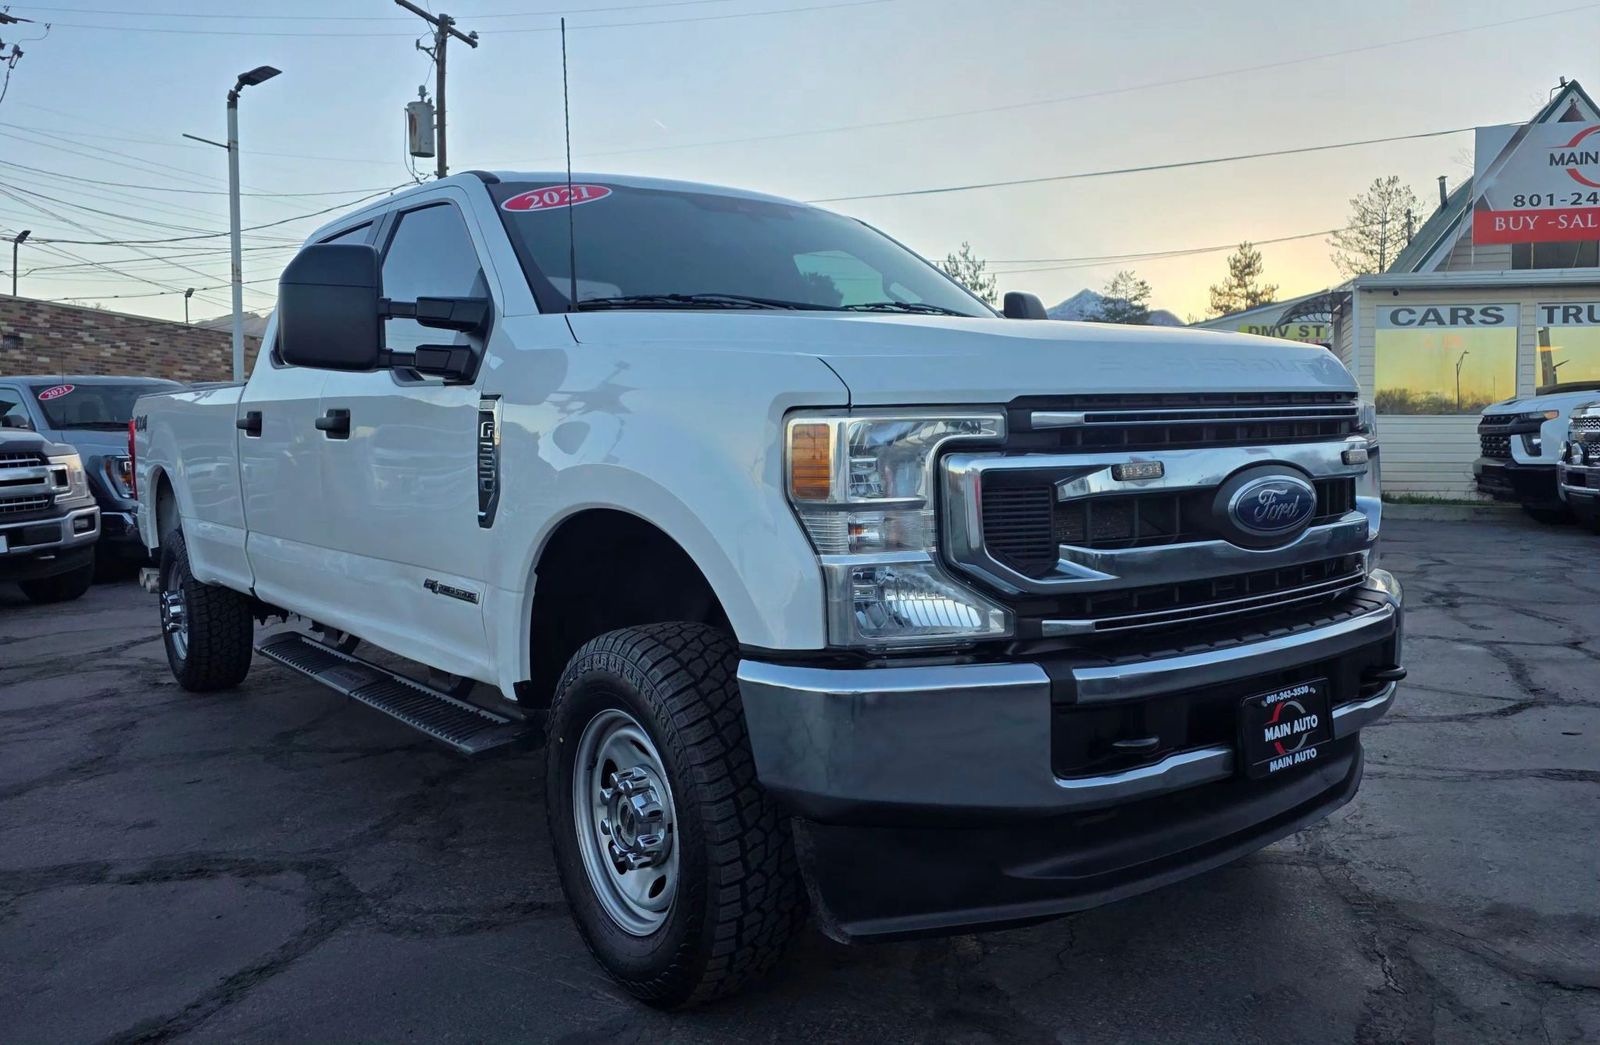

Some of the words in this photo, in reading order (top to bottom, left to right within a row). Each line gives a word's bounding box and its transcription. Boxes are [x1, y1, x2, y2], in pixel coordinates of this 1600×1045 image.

[1549, 151, 1599, 166] MAIN
[525, 186, 592, 209] 2021
[1513, 191, 1600, 208] 801-24
[1495, 215, 1540, 231] BUY
[1389, 306, 1505, 327] CARS
[1541, 305, 1600, 324] TRU
[1298, 324, 1324, 338] ST
[44, 386, 68, 399] 2021
[1254, 489, 1300, 521] Ford
[1264, 722, 1291, 742] MAIN
[1293, 714, 1318, 734] AUTO
[1269, 754, 1293, 773] MAIN
[1294, 747, 1317, 764] AUTO
